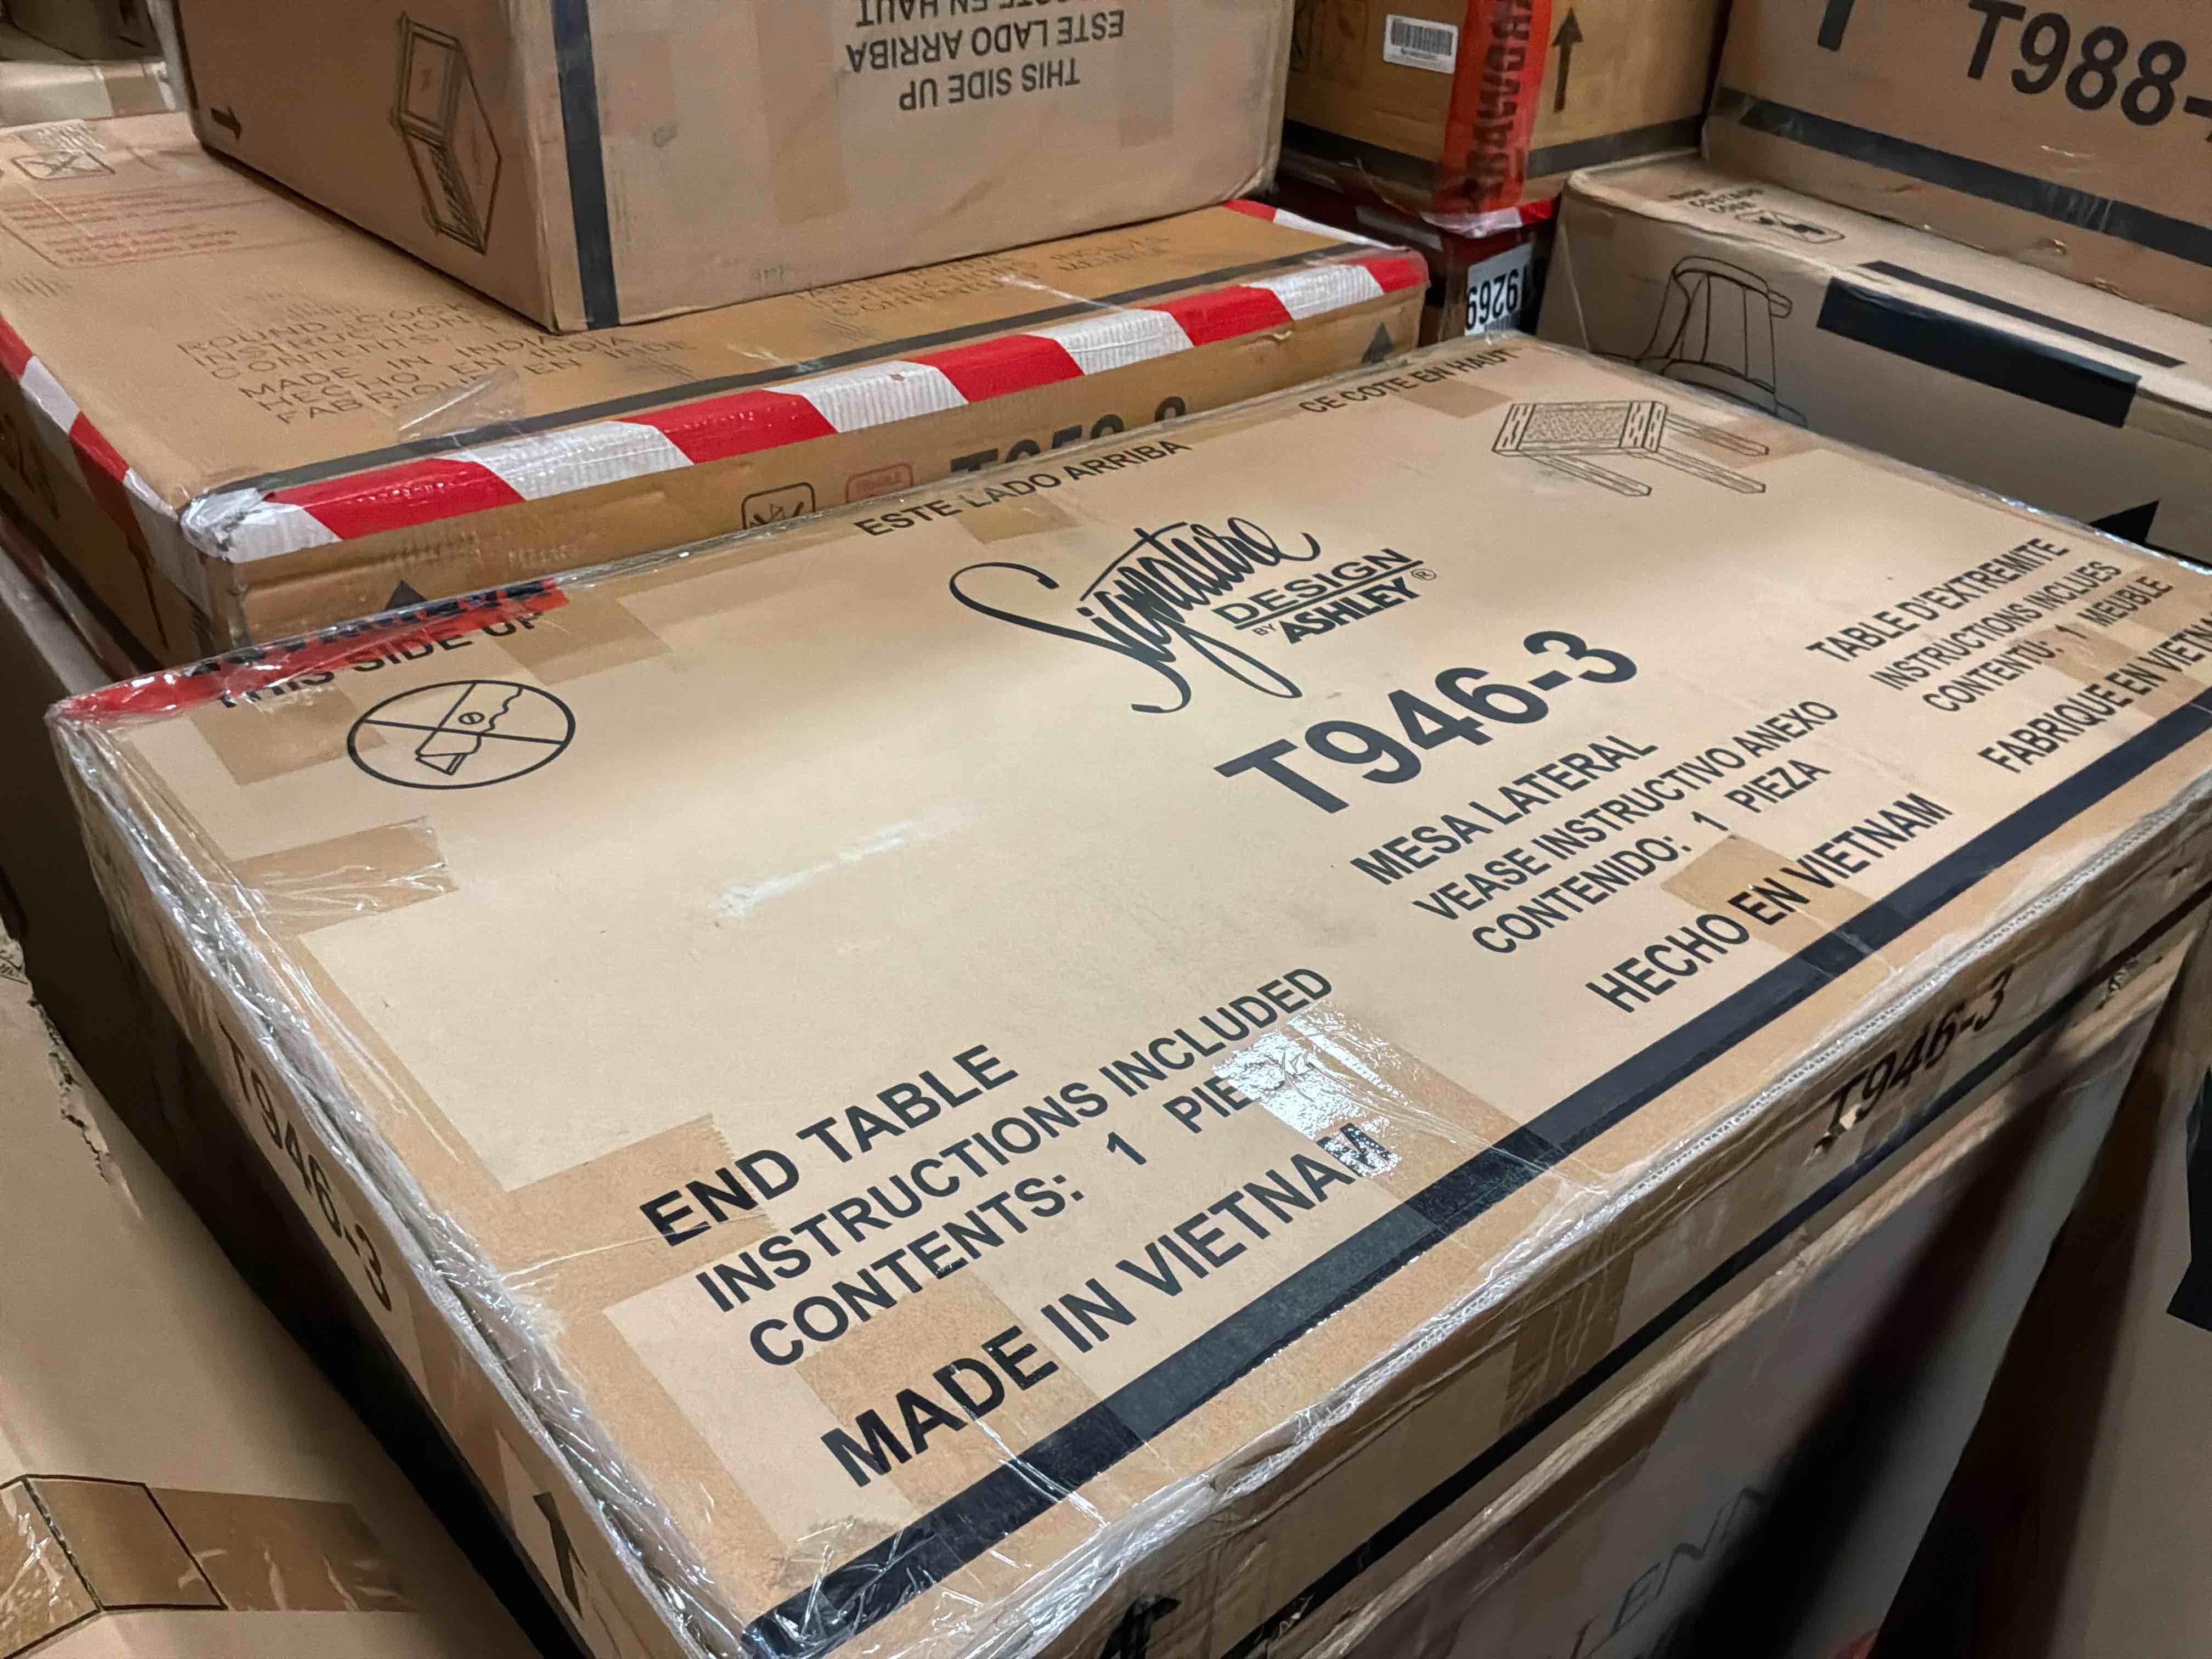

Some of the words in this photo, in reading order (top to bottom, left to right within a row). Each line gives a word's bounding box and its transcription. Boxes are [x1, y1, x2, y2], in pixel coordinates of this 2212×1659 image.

[846, 29, 963, 72] ARRIBA
[948, 67, 1012, 103] SIDE
[972, 19, 1048, 56] LADO
[1022, 58, 1080, 92] THIS
[1057, 9, 1125, 46] ESTE
[1967, 0, 2212, 142] T988-
[899, 78, 939, 110] UP
[238, 367, 360, 398] MADE
[387, 356, 434, 370] IN
[258, 371, 421, 411] HECHO
[449, 357, 507, 375] EN
[524, 358, 583, 375] EN
[1299, 396, 1347, 414] CE
[1339, 377, 1419, 402] COTE
[1408, 365, 1456, 383] EN
[1446, 348, 1520, 373] HAUT
[852, 499, 963, 537] ESTE
[958, 473, 1062, 508] LADO
[1063, 439, 1192, 481] ARRIBA
[949, 517, 1321, 714] Signature
[1211, 548, 1413, 624] DESIGN
[1251, 623, 1278, 636] BY
[1278, 576, 1422, 645] ASHLEY
[1805, 610, 1921, 662] TABLE
[1894, 538, 2070, 620] D'EXTREMITE
[1869, 603, 2042, 691] INSTRUCTIONS
[2022, 560, 2122, 610] INCLUES
[2055, 624, 2088, 640] 1
[2076, 575, 2173, 627] MEUBLE
[1213, 630, 1638, 814] T946-3
[1977, 683, 2133, 773] FABRIQUE
[2104, 663, 2168, 695] EN
[2136, 610, 2212, 673] VIETN
[1350, 814, 1494, 885] MESA
[1468, 735, 1659, 825] LATERAL
[1412, 848, 1553, 921] VEASE
[1531, 747, 1746, 860] INSTRUCTIVO
[1732, 701, 1838, 758] ANEXO
[1472, 835, 1692, 953] CONTENIDO:
[1690, 810, 1729, 832] 1
[1723, 758, 1832, 813] PIEZA
[1585, 913, 1750, 1013] HECHO
[1727, 877, 1811, 926] EN
[1780, 792, 1954, 889] VIETNAM
[1822, 963, 2015, 1138] T946-3
[219, 1022, 393, 1312] T946-3
[639, 1149, 800, 1246] END
[795, 1043, 1019, 1163] TABLE
[696, 1082, 1109, 1312] INSTRUCTIONS
[1098, 968, 1333, 1097] INCLUDED
[749, 1174, 1085, 1365] CONTENTS:
[1106, 1131, 1147, 1166] 1
[819, 1325, 1059, 1487] MADE
[1040, 1277, 1137, 1353] IN
[1115, 1122, 1400, 1296] VIETNAM
